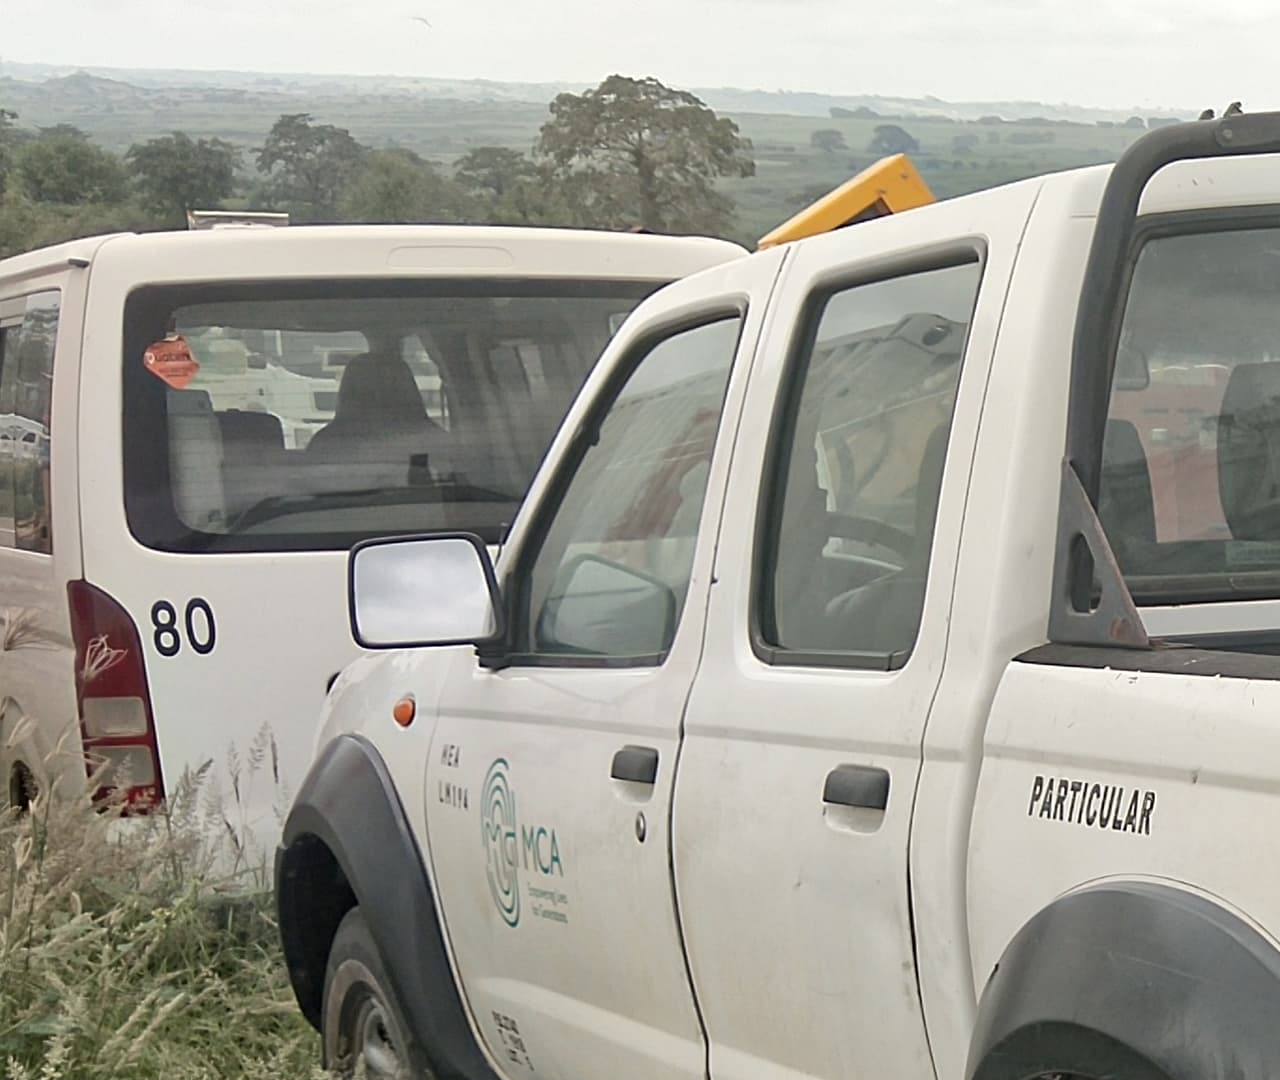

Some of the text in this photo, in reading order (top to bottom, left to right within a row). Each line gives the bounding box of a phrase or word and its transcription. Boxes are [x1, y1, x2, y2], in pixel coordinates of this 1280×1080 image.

[151, 597, 216, 657] 80
[1028, 776, 1155, 835] PARTICULAR
[521, 824, 564, 877] MCA
